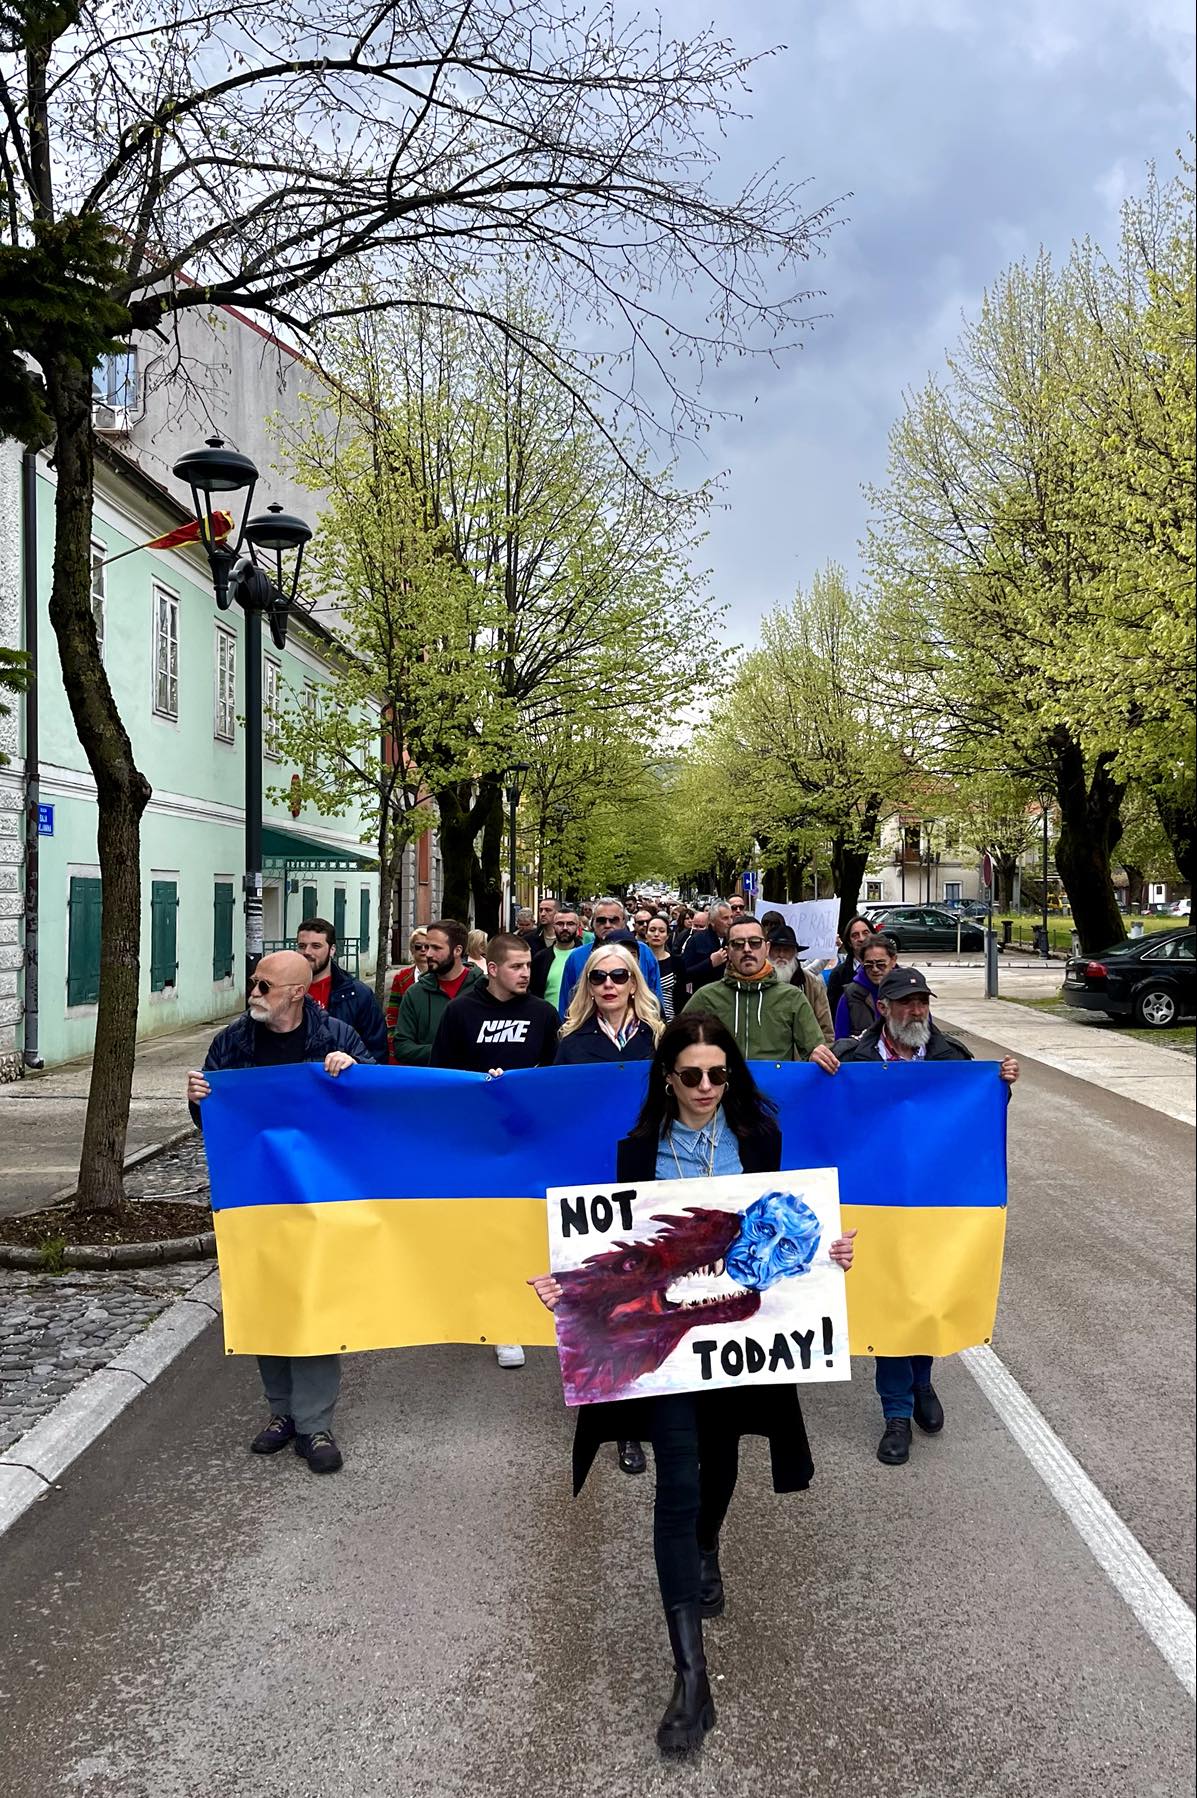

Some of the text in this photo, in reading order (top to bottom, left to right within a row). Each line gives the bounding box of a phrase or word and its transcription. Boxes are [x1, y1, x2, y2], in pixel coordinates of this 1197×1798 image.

[476, 1020, 531, 1043] NIKE
[560, 1189, 637, 1238] NOT
[692, 1316, 834, 1380] TODAY!
